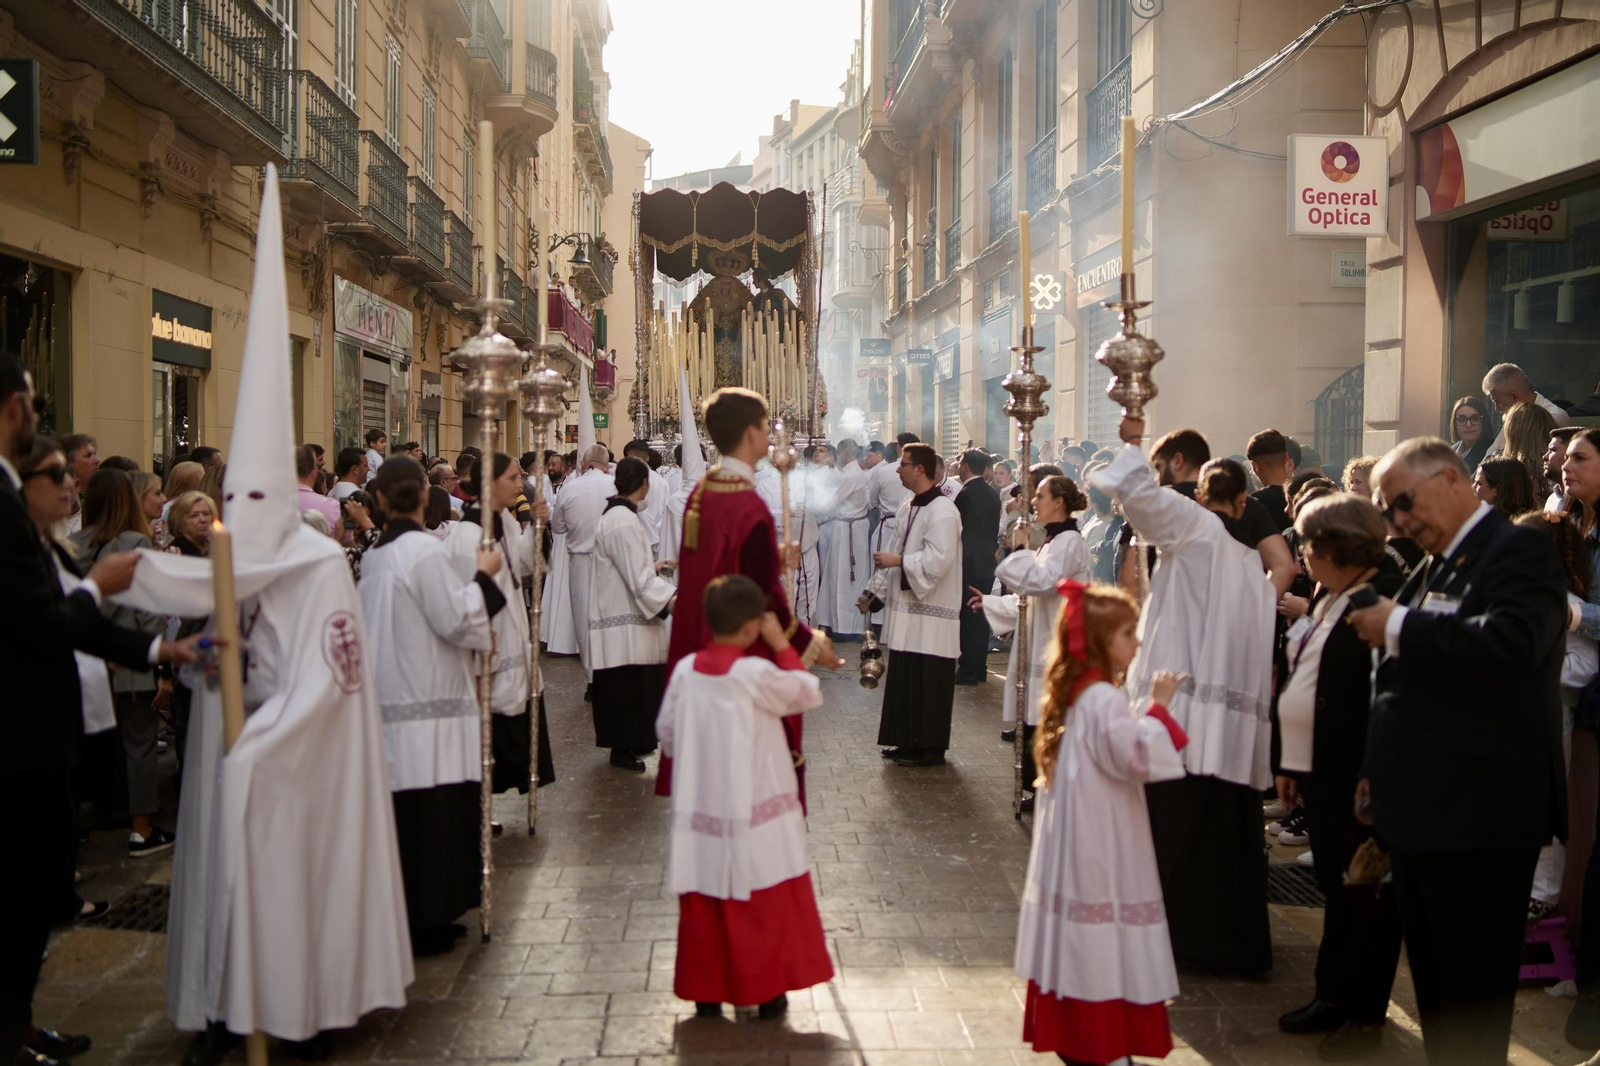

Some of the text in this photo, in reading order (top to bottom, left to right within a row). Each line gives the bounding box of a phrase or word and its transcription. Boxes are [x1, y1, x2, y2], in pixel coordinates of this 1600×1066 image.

[1301, 187, 1378, 206] General
[1308, 207, 1371, 229] Optica
[1077, 256, 1122, 293] ENCUENTRO
[173, 317, 212, 349] banana
[358, 301, 396, 340] MENTA
